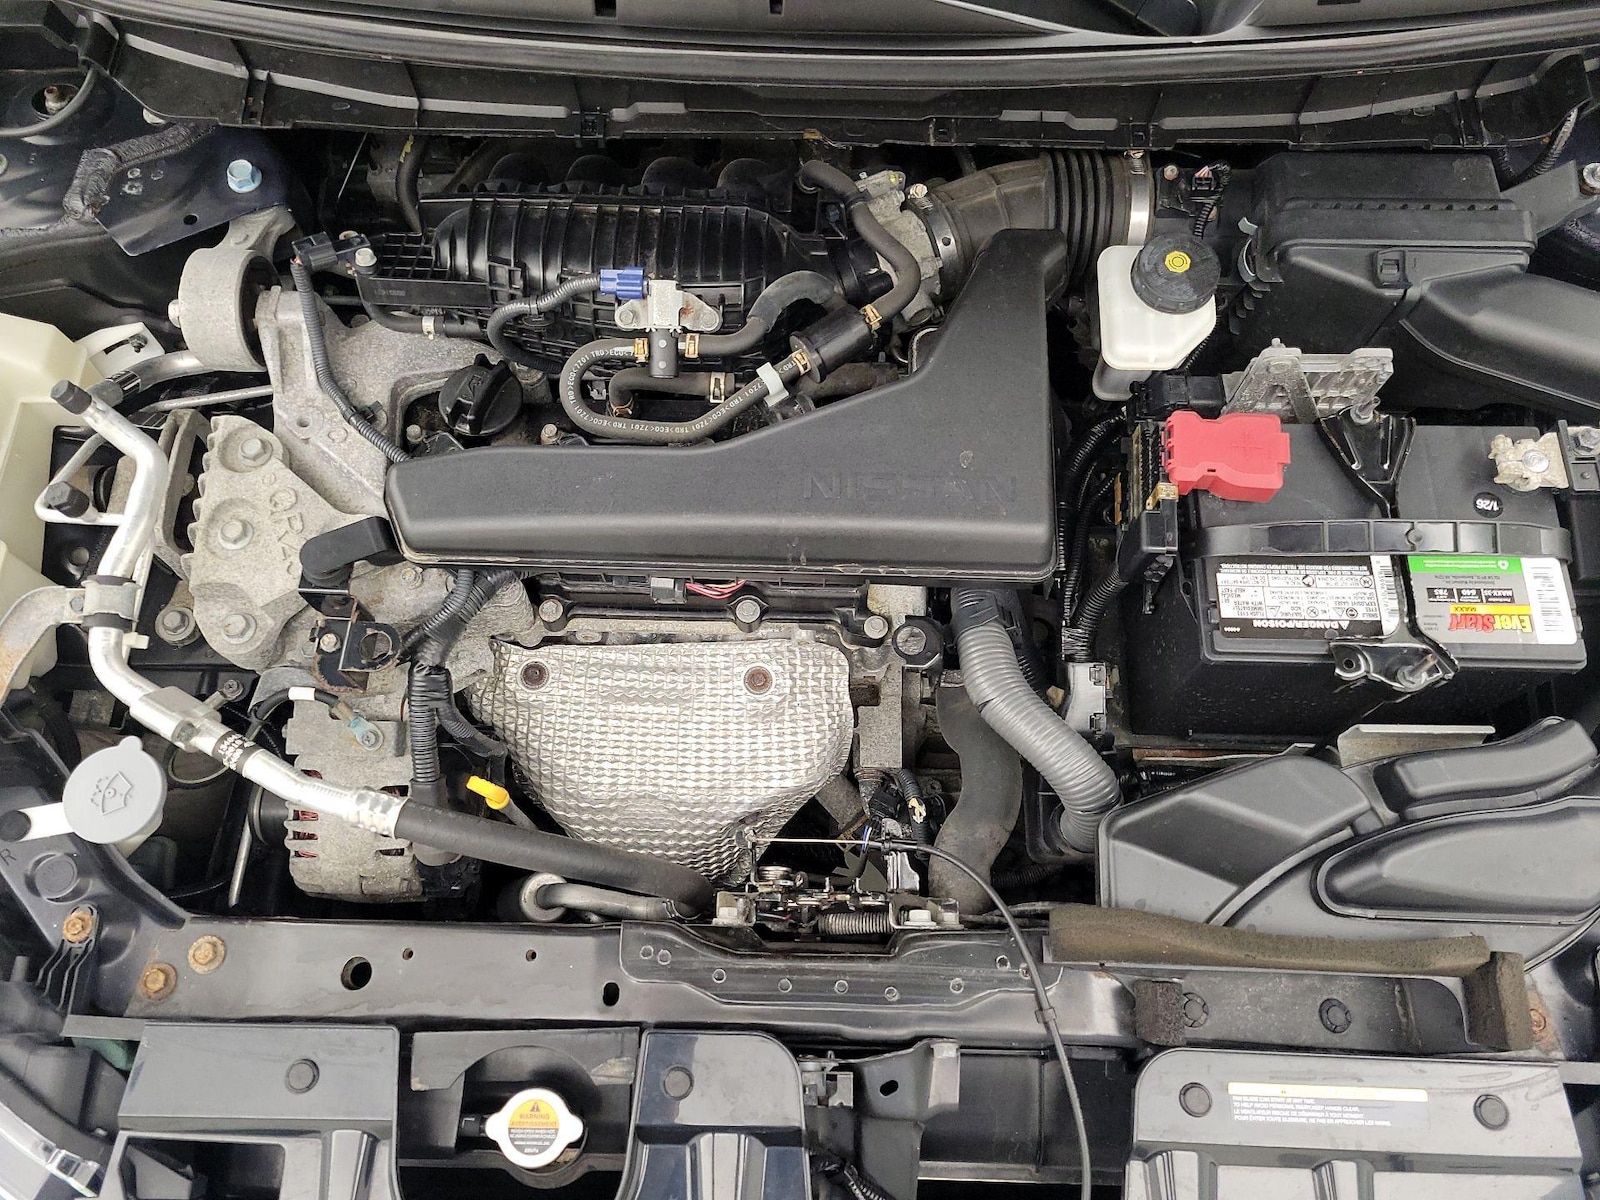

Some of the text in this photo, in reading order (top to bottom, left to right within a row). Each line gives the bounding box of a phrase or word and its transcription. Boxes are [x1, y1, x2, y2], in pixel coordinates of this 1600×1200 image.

[802, 471, 1016, 503] NISSAN
[1476, 498, 1499, 512] 1/26
[1253, 620, 1339, 629] DANGER/POISON
[1449, 614, 1533, 633] EverStart
